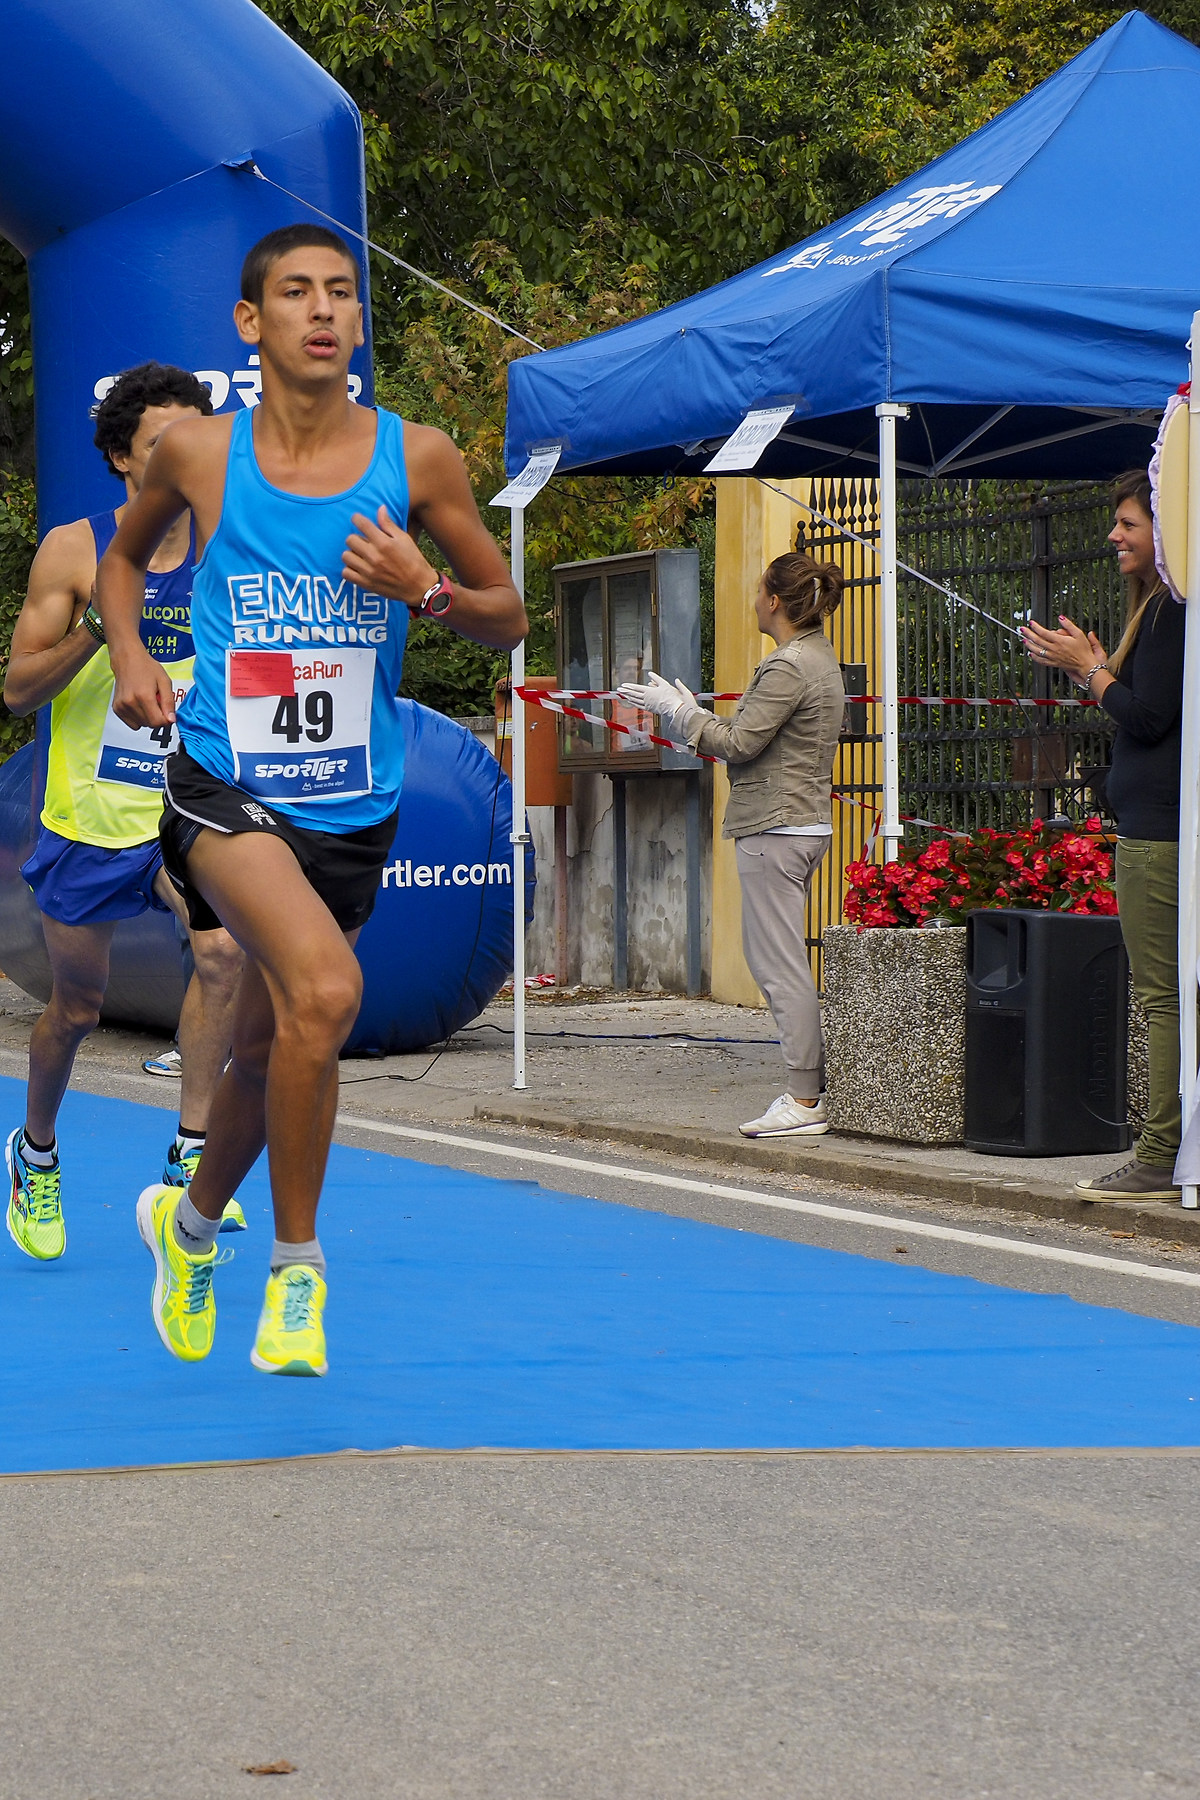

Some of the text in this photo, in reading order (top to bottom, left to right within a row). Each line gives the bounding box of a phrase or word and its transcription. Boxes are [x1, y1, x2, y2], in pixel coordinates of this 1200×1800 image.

[234, 625, 387, 644] RUNNING
[293, 660, 343, 680] caRun
[272, 690, 334, 744] 49
[115, 756, 166, 777] SPOR
[254, 756, 349, 781] SPORTLER
[377, 859, 512, 889] rtler.com
